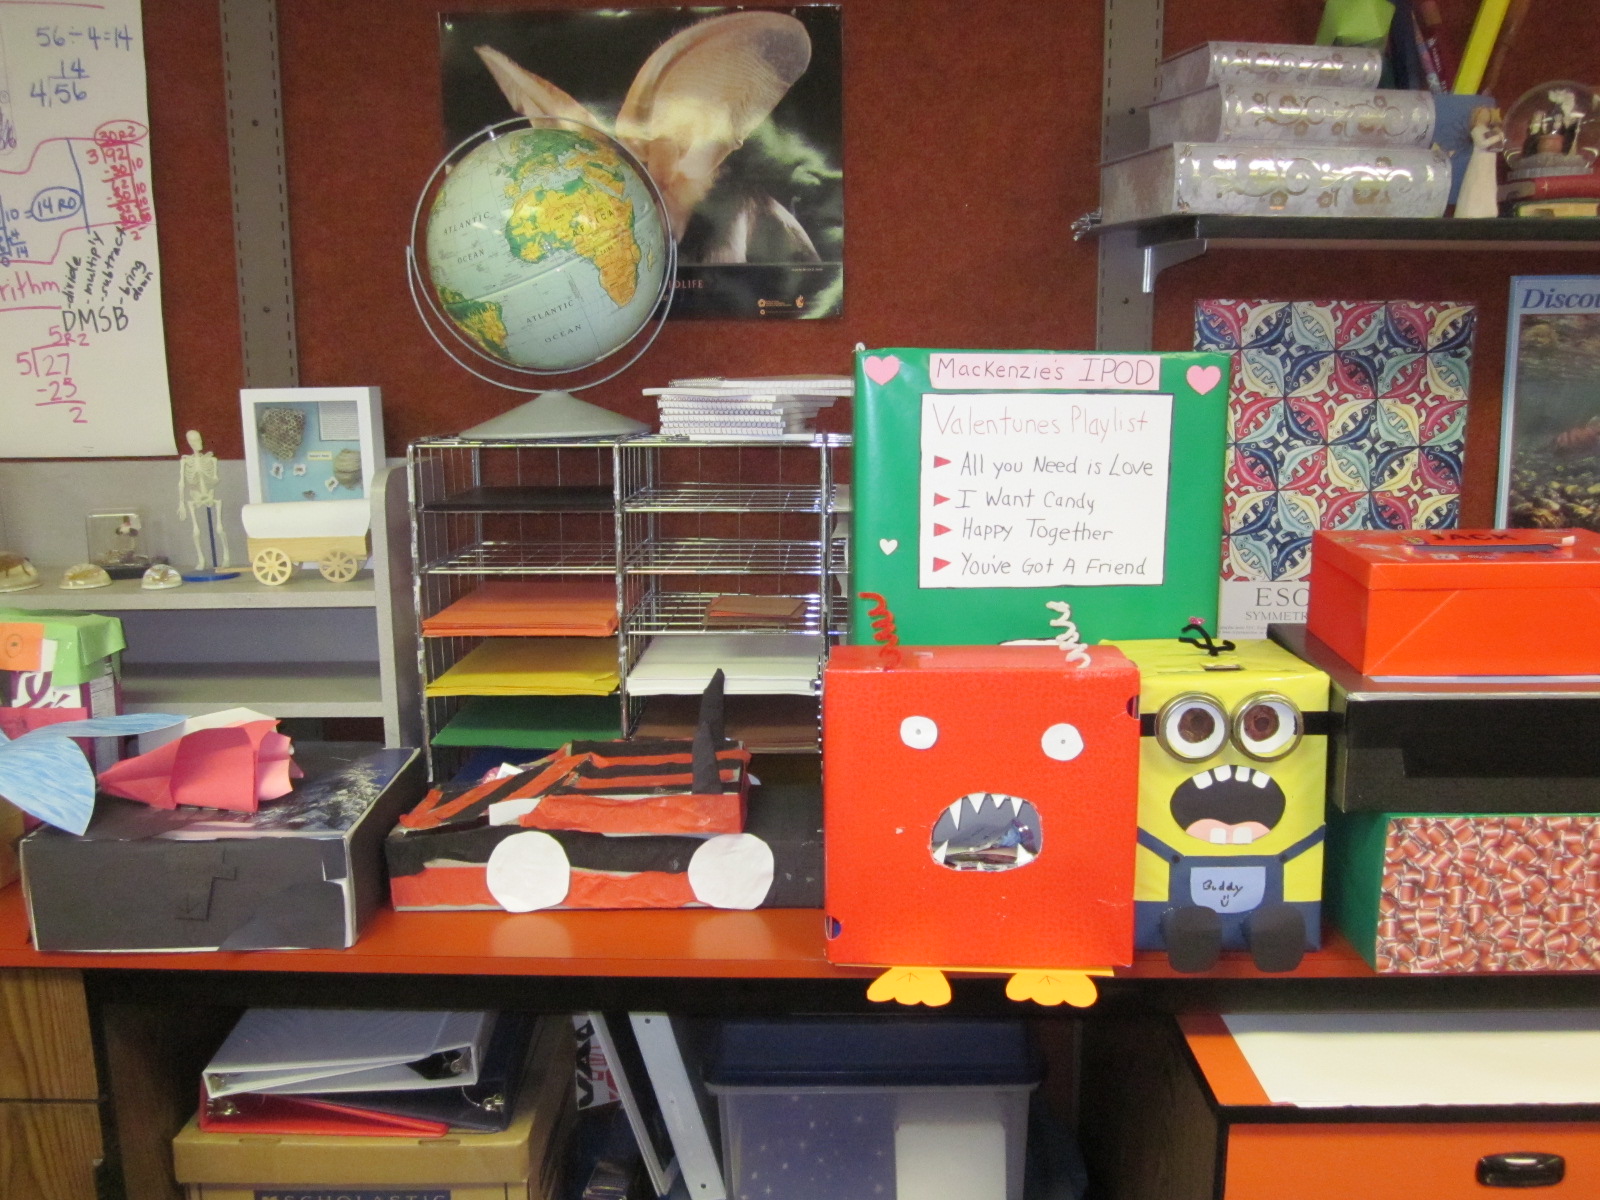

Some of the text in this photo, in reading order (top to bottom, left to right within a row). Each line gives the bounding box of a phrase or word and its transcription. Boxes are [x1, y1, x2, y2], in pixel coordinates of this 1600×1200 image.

[443, 211, 490, 236] ATLANTIC
[457, 248, 485, 263] OCEAN
[61, 305, 129, 334] DMSB
[526, 300, 574, 324] ATLANTIC
[544, 323, 582, 343] OCEAN
[1078, 357, 1156, 386] IPOD
[932, 403, 1148, 443] Valentunes Playlist
[960, 451, 1154, 479] All you Need is Love
[955, 486, 1095, 515] I Want Candy
[962, 516, 1113, 546] Happy Together
[961, 551, 1148, 575] You've Got A Friend
[1202, 879, 1243, 898] Buddy
